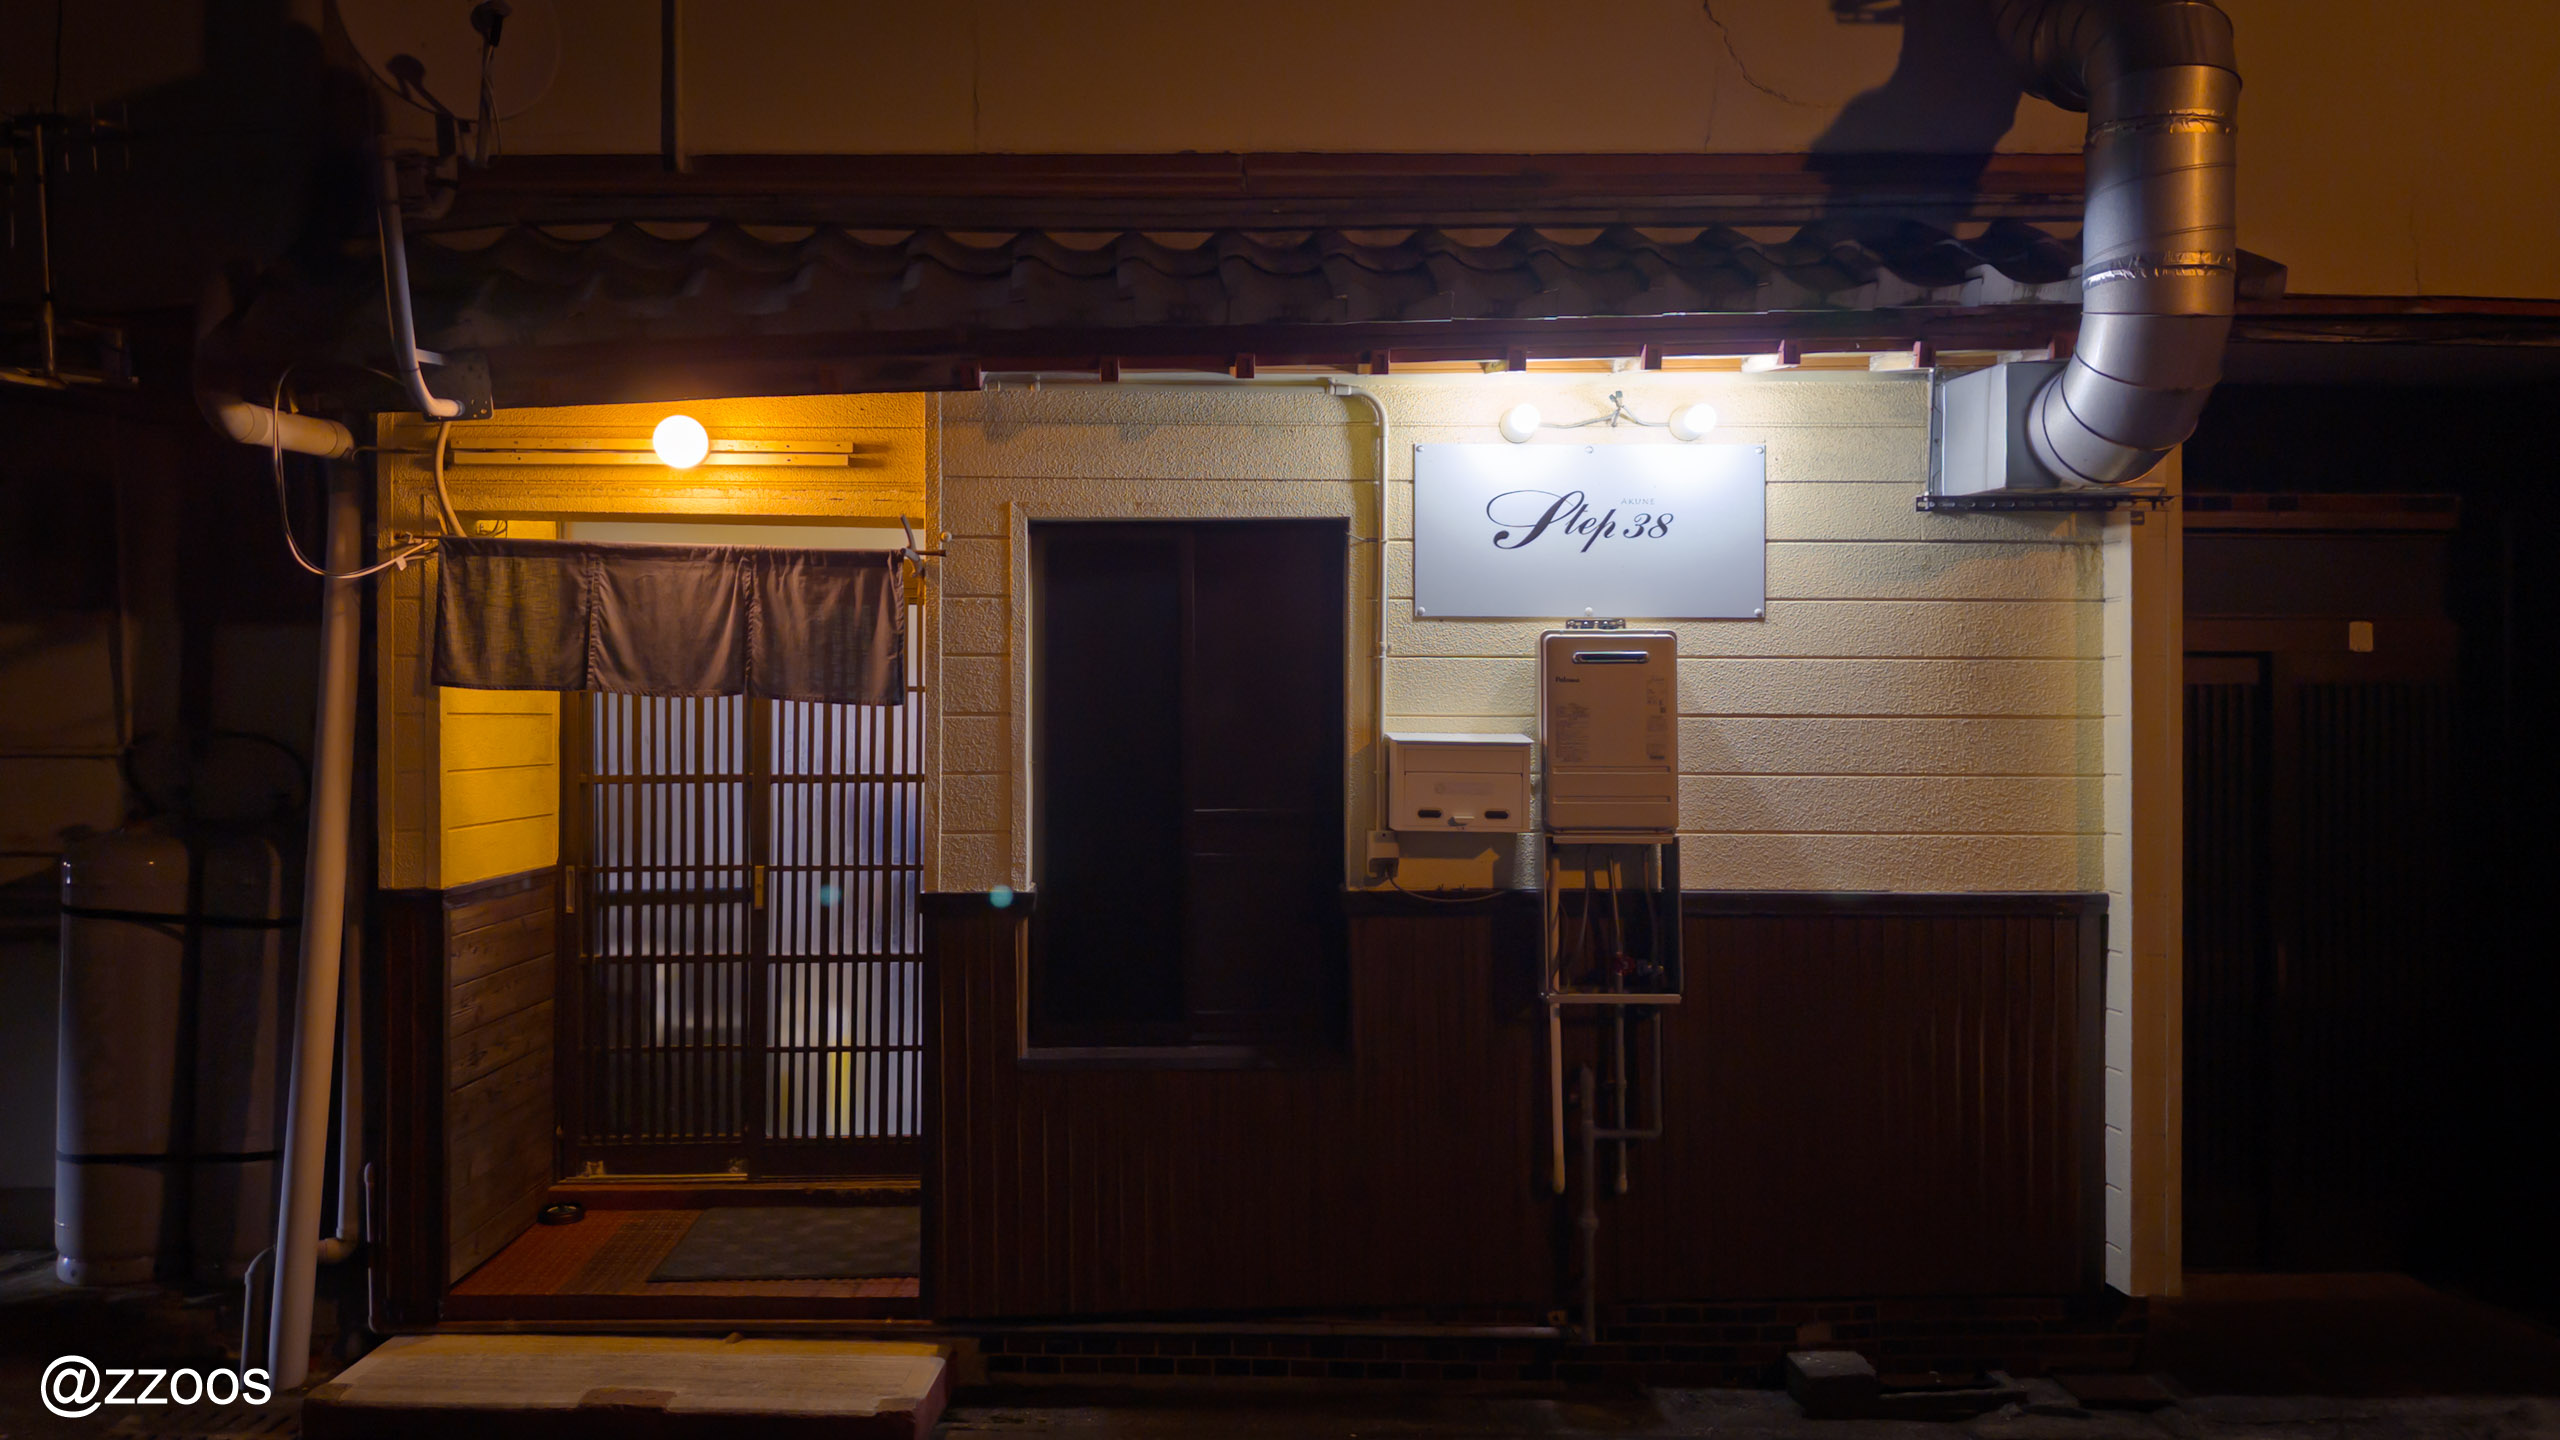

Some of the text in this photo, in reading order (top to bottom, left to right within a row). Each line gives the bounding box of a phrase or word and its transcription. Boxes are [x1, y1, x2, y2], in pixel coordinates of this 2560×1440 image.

[1620, 497, 1656, 506] AKUNE
[1486, 489, 1675, 553] Step 38
